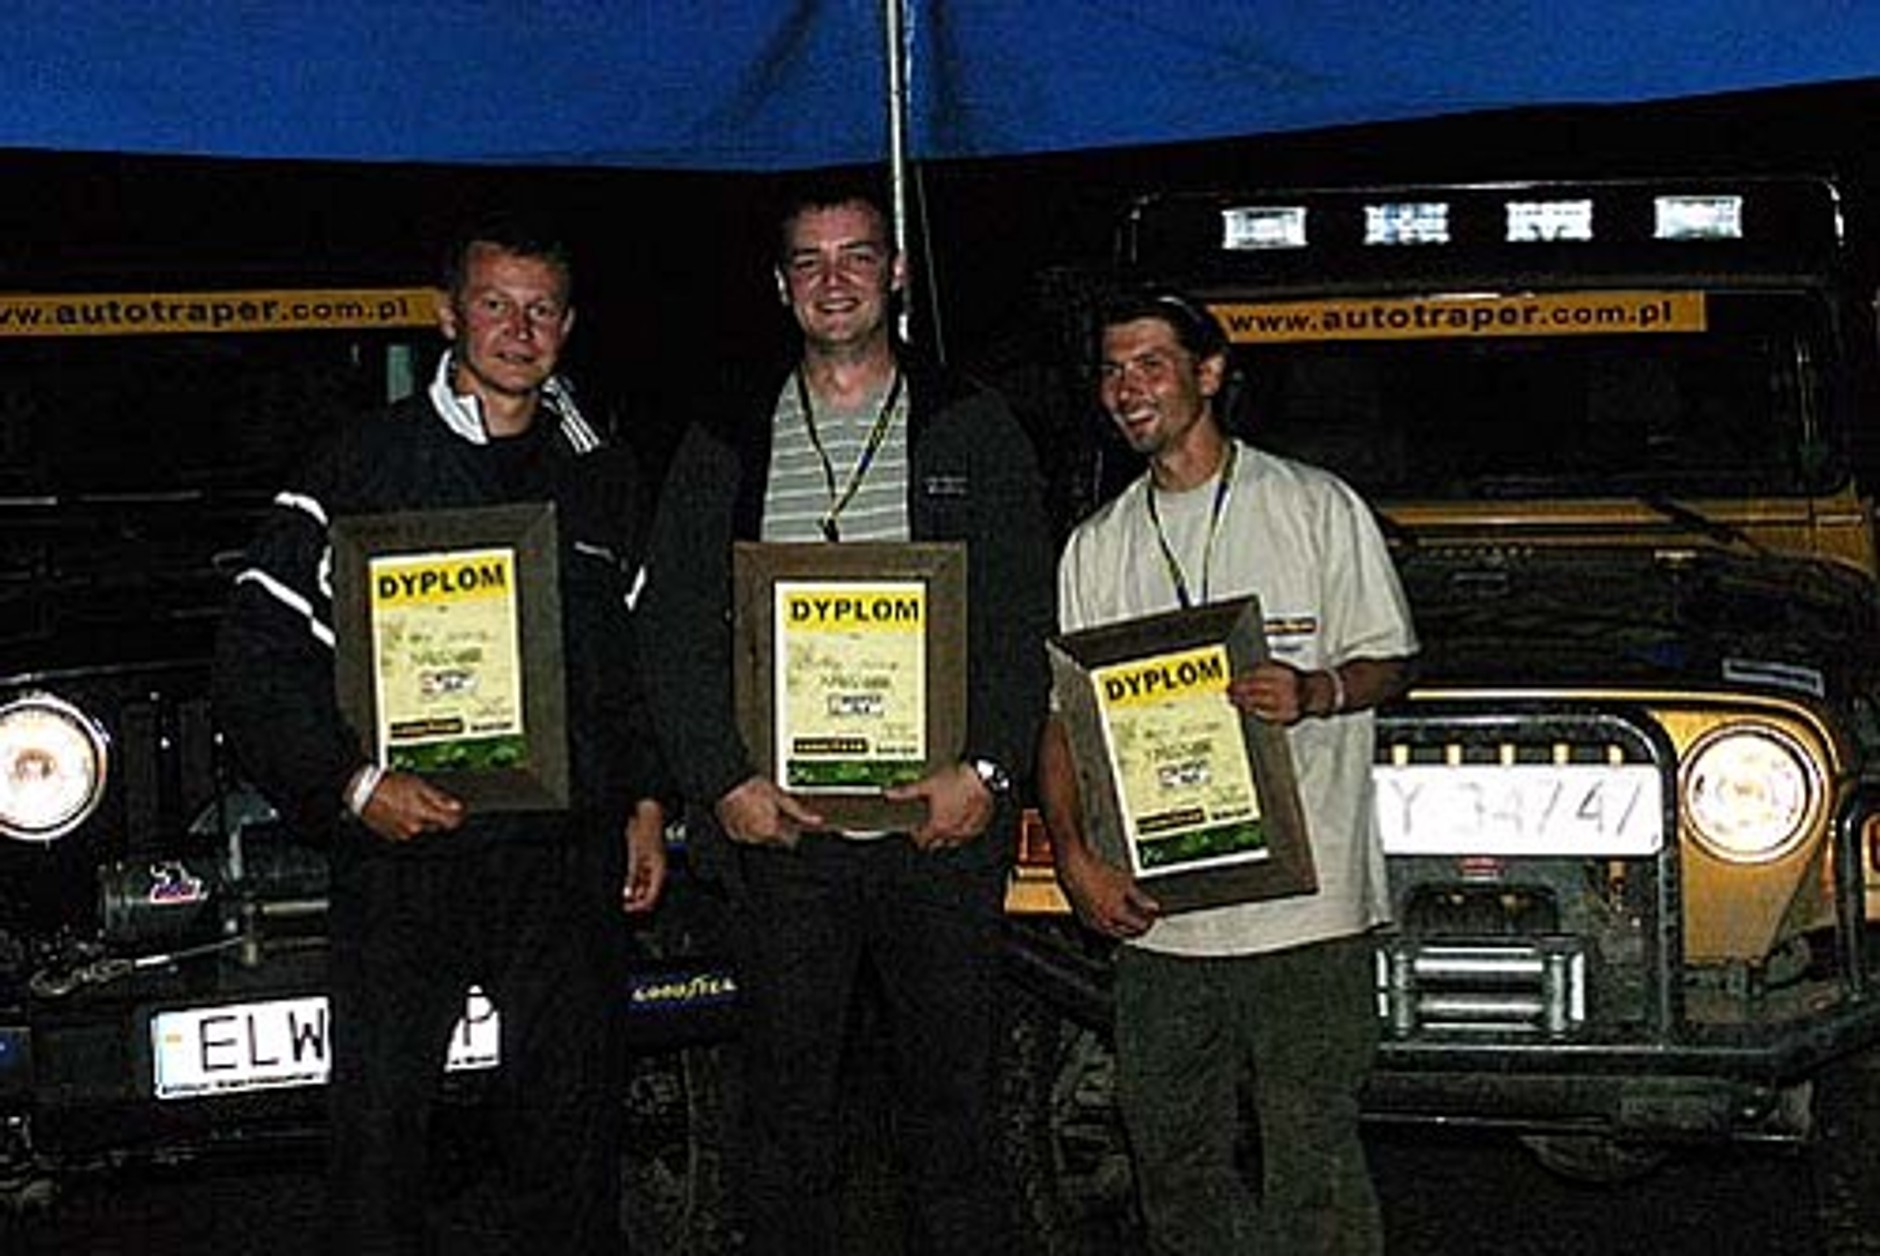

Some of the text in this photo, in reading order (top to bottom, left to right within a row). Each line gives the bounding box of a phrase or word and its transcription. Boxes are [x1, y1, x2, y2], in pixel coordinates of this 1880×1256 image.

[1230, 301, 1672, 332] www.autotraper.com.pl
[379, 564, 505, 599] DYPLOM
[790, 599, 919, 621] DYPLOM
[1105, 656, 1224, 700] DYPLOM
[199, 1008, 325, 1072] ELW
